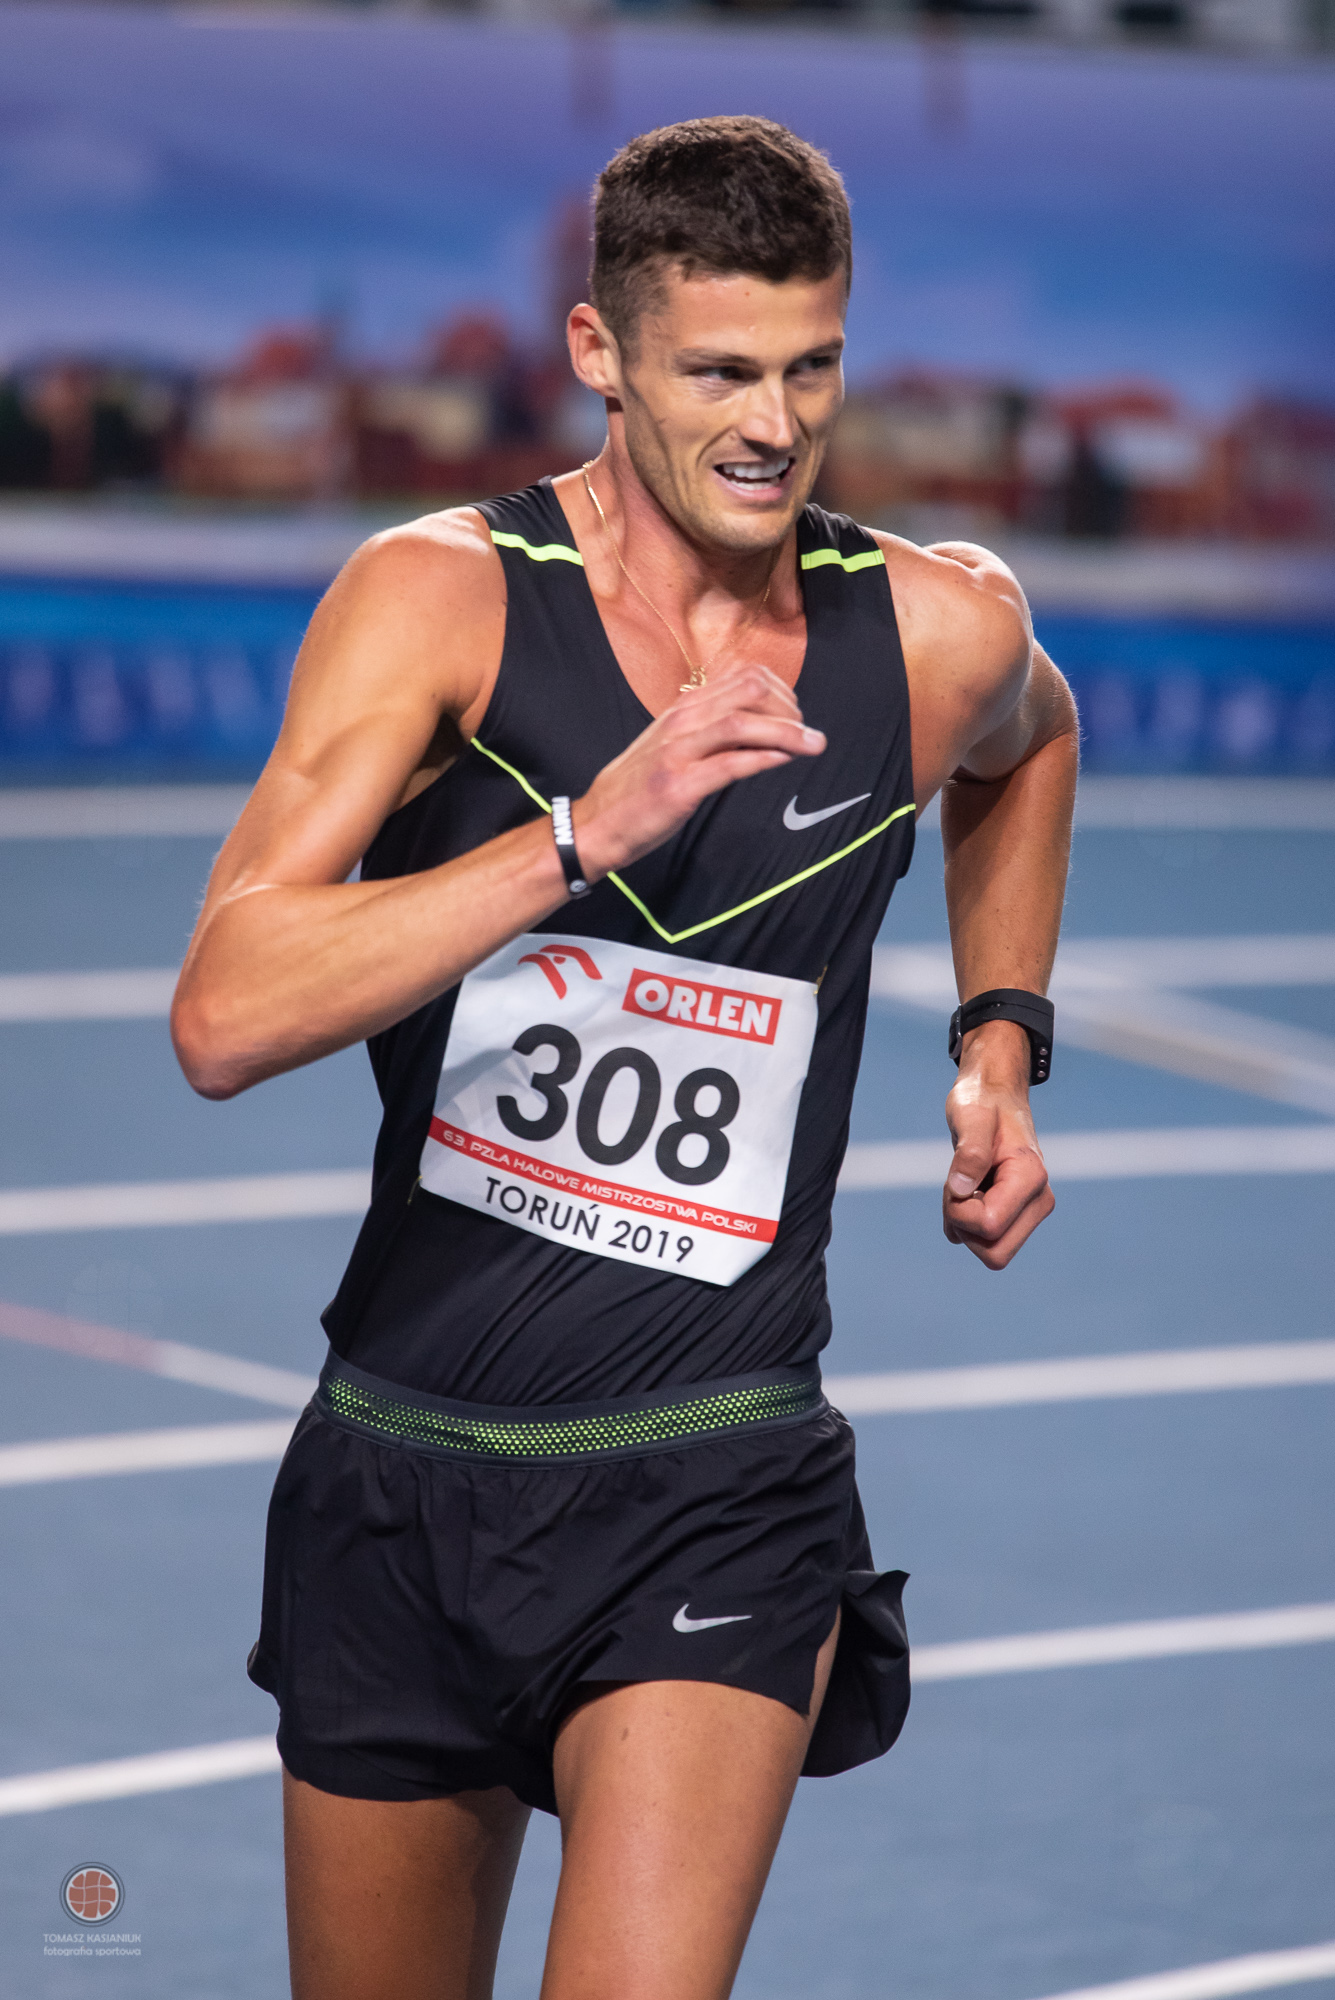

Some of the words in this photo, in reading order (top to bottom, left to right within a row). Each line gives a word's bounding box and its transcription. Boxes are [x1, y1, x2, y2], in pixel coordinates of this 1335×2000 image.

[634, 978, 773, 1038] ORLEN
[496, 1023, 741, 1187] 308
[470, 1142, 510, 1166] PZLA
[513, 1158, 580, 1190] HALOWE
[582, 1182, 698, 1221] MISTRZOSTWA
[701, 1211, 757, 1234] POLSKI
[486, 1176, 601, 1241] TORUŃ
[607, 1219, 694, 1264] 2019
